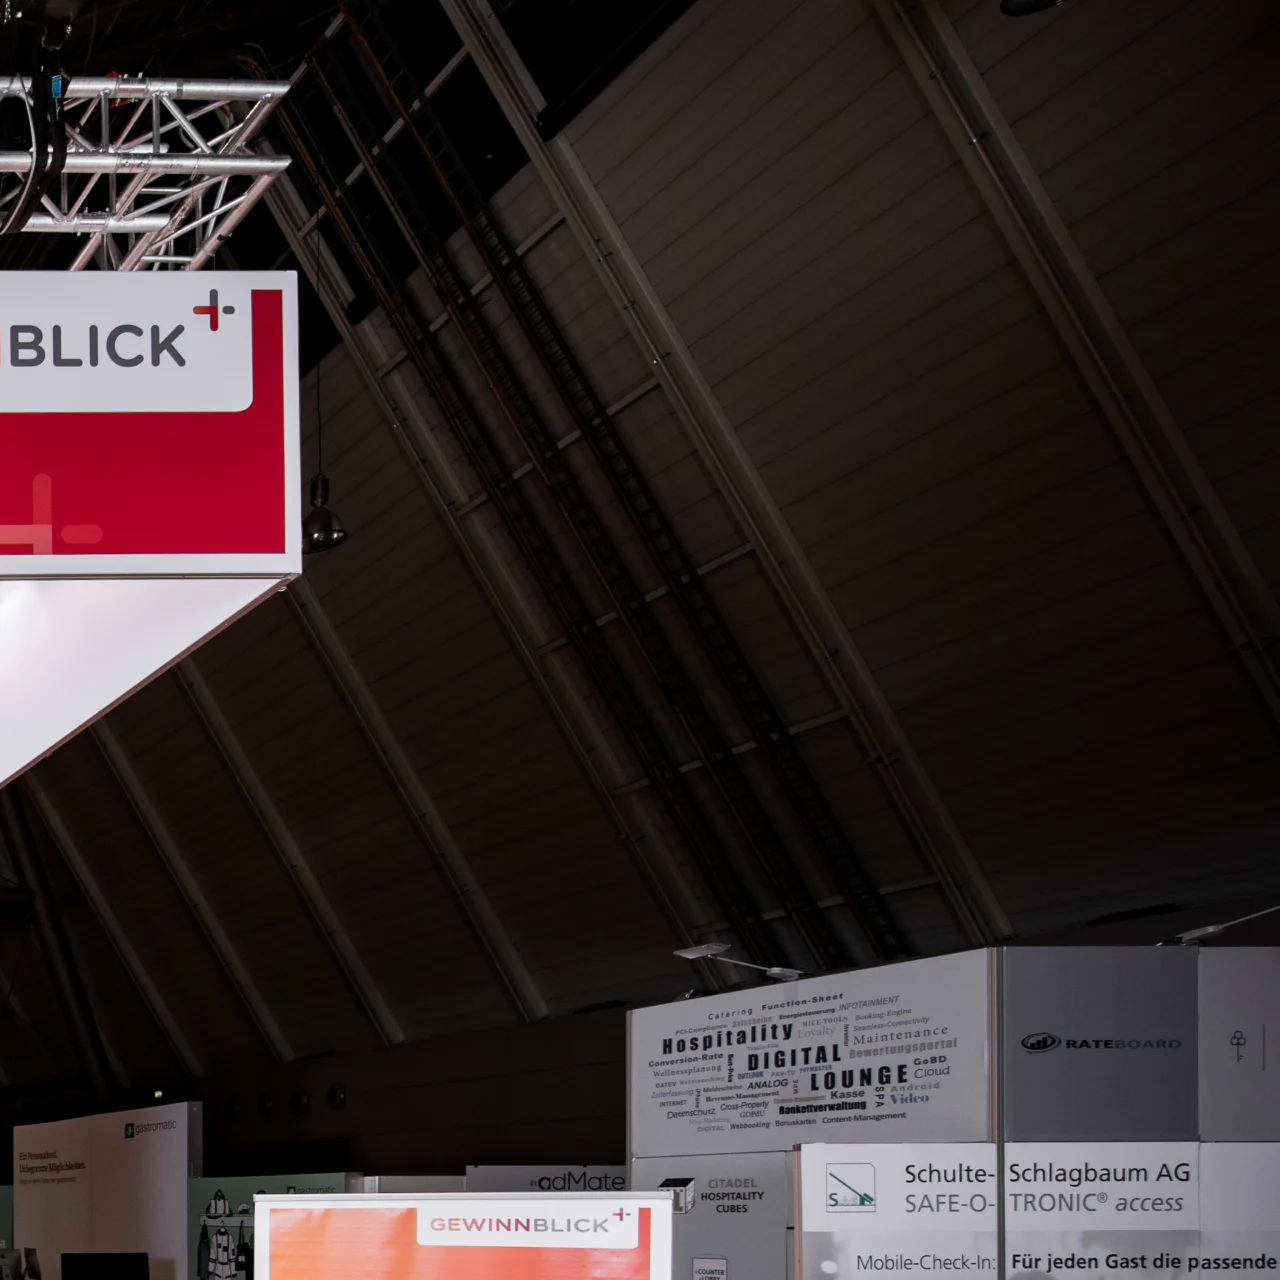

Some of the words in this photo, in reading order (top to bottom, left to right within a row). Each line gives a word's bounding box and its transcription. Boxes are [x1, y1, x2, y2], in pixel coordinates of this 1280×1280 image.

[761, 993, 844, 1011] Function-Sheet
[838, 995, 900, 1012] INFOTAINMENT
[708, 1008, 753, 1021] Catering
[778, 1007, 836, 1021] Energiesteuerung
[854, 1007, 913, 1022] Booking-Engine
[853, 1016, 930, 1033] Seamless-Connectivity
[662, 1022, 793, 1055] Hospitality
[853, 1026, 949, 1046] Maintenance
[849, 1037, 958, 1060] Bewertungsportal
[1065, 1038, 1182, 1050] RATEBOARD
[648, 1053, 724, 1068] Conversion-Rate
[747, 1044, 841, 1072] DIGITAL
[913, 1055, 947, 1066] GoBD
[653, 1064, 722, 1078] Wellnessplanung
[810, 1064, 908, 1092] LOUNGE
[913, 1065, 951, 1079] Cloud
[746, 1078, 789, 1091] ANALOG
[890, 1081, 941, 1093] Android
[830, 1090, 866, 1100] Kasse
[889, 1093, 930, 1105] Video
[666, 1108, 716, 1120] Datenschutz
[719, 1101, 770, 1112] Cross-Property
[778, 1100, 867, 1116] Bankettverwaltung
[729, 1120, 771, 1131] Webbooking
[774, 1118, 817, 1127] Bonuskarten
[821, 1112, 907, 1124] Content-Management
[135, 1119, 177, 1136] gastromatic
[905, 1163, 996, 1183] Schulte-
[1009, 1162, 1149, 1188] Schlagbaum
[1156, 1163, 1191, 1182] AG
[538, 1171, 626, 1191] adMate
[707, 1178, 758, 1189] CITADEL
[700, 1191, 765, 1201] HOSPITALITY
[905, 1193, 996, 1213] SAFE-O-
[715, 1204, 748, 1213] CUBES
[1115, 1195, 1184, 1213] access
[430, 1217, 609, 1233] GEWINNBLICK
[856, 1254, 997, 1271] Mobile-Check-In:
[1012, 1252, 1042, 1269] Für
[1046, 1253, 1099, 1273] jeden
[1105, 1254, 1147, 1270] Gast
[1153, 1253, 1182, 1270] die
[1187, 1253, 1278, 1274] passende
